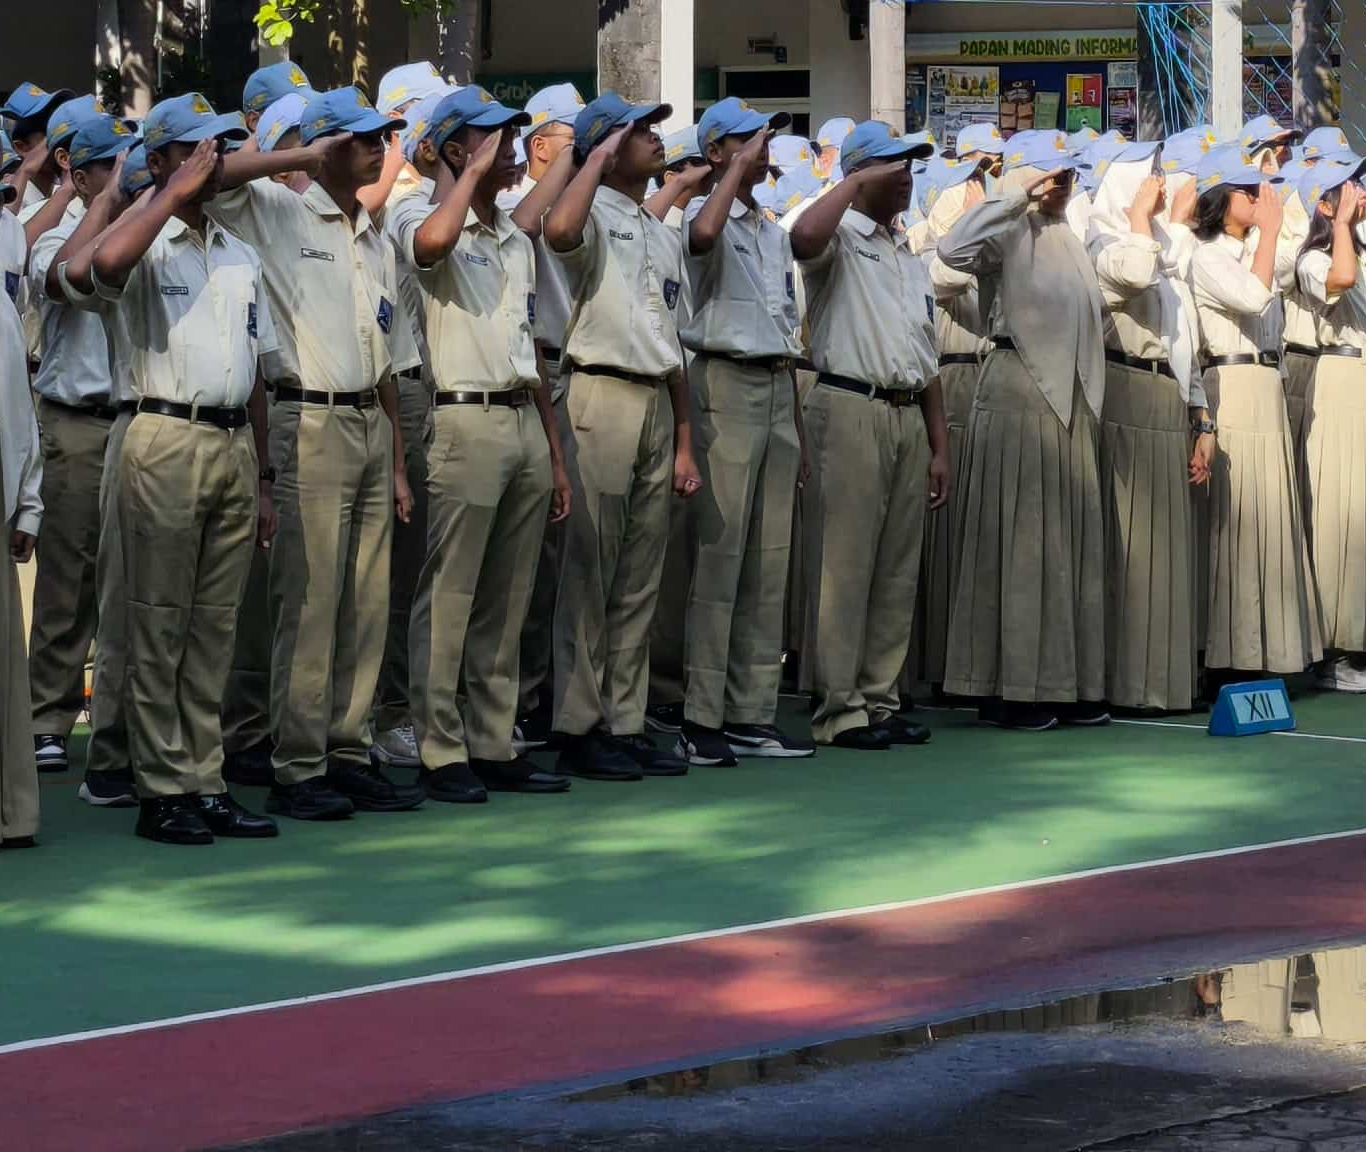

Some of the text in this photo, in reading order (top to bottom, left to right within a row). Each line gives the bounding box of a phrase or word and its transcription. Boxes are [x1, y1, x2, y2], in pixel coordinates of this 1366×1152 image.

[960, 39, 1009, 56] PAPAN
[1013, 38, 1071, 55] MADING
[1244, 692, 1274, 721] XII
